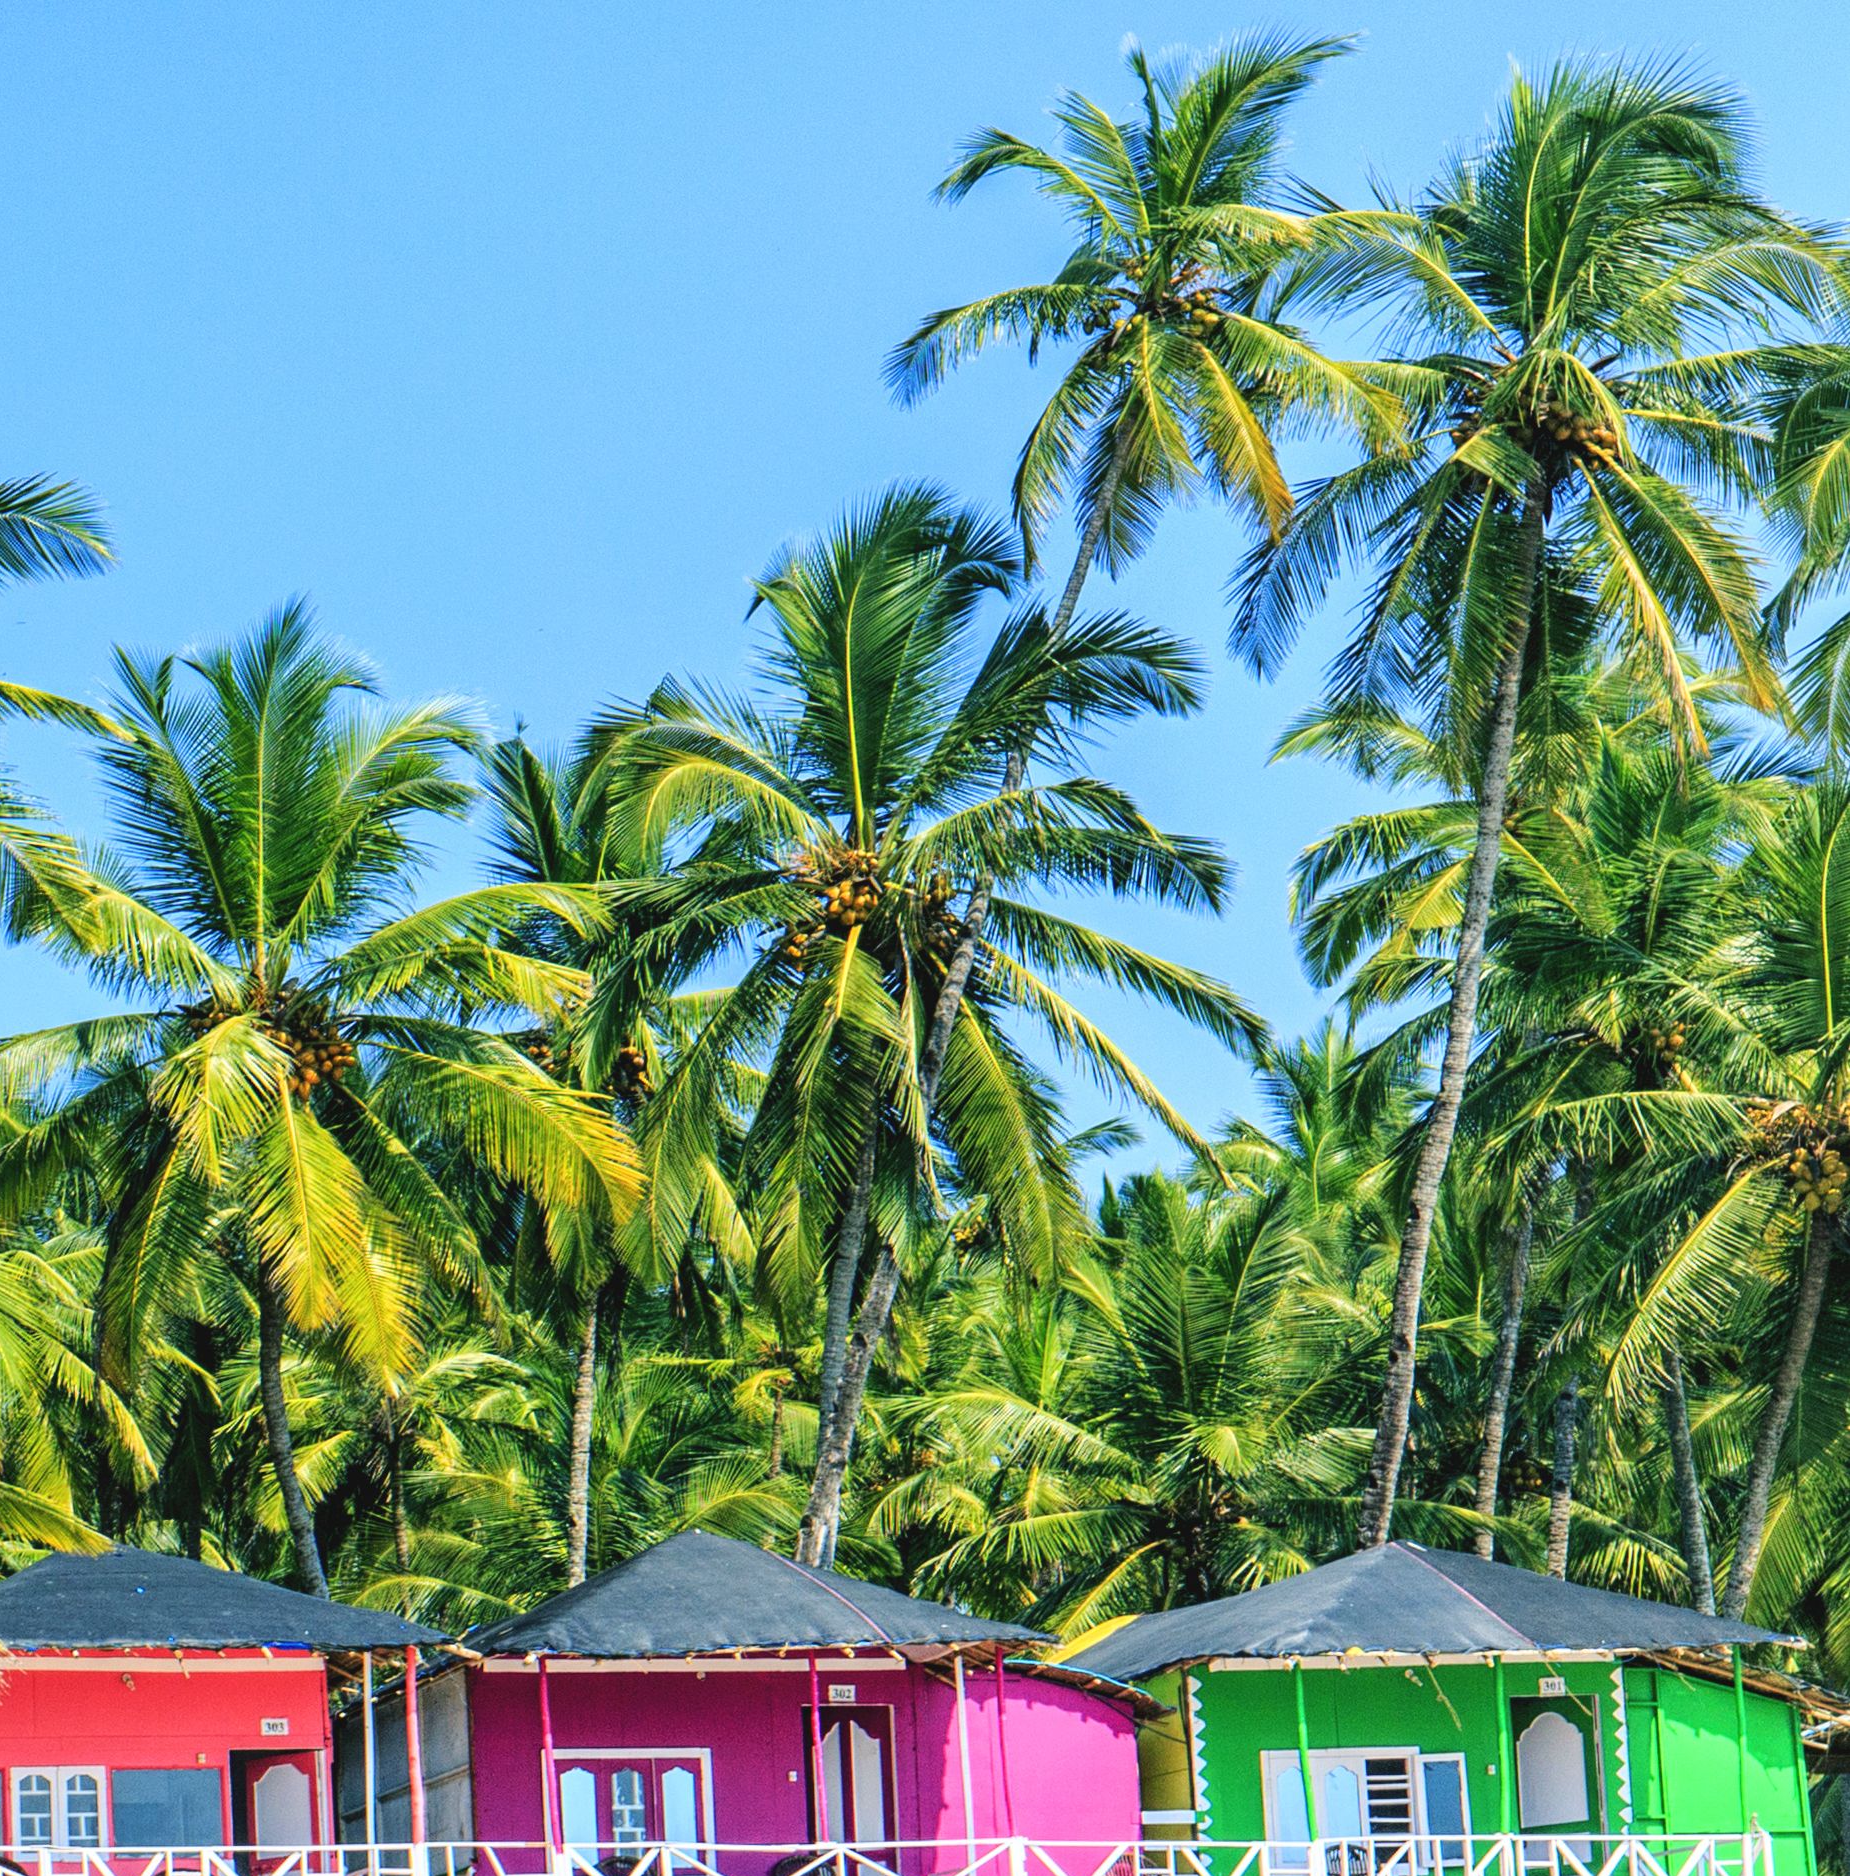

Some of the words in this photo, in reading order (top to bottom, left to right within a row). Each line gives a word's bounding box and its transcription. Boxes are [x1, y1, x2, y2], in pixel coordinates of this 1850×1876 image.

[1543, 1681, 1561, 1691] 301
[832, 1688, 852, 1699] 302
[265, 1722, 285, 1733] 303
